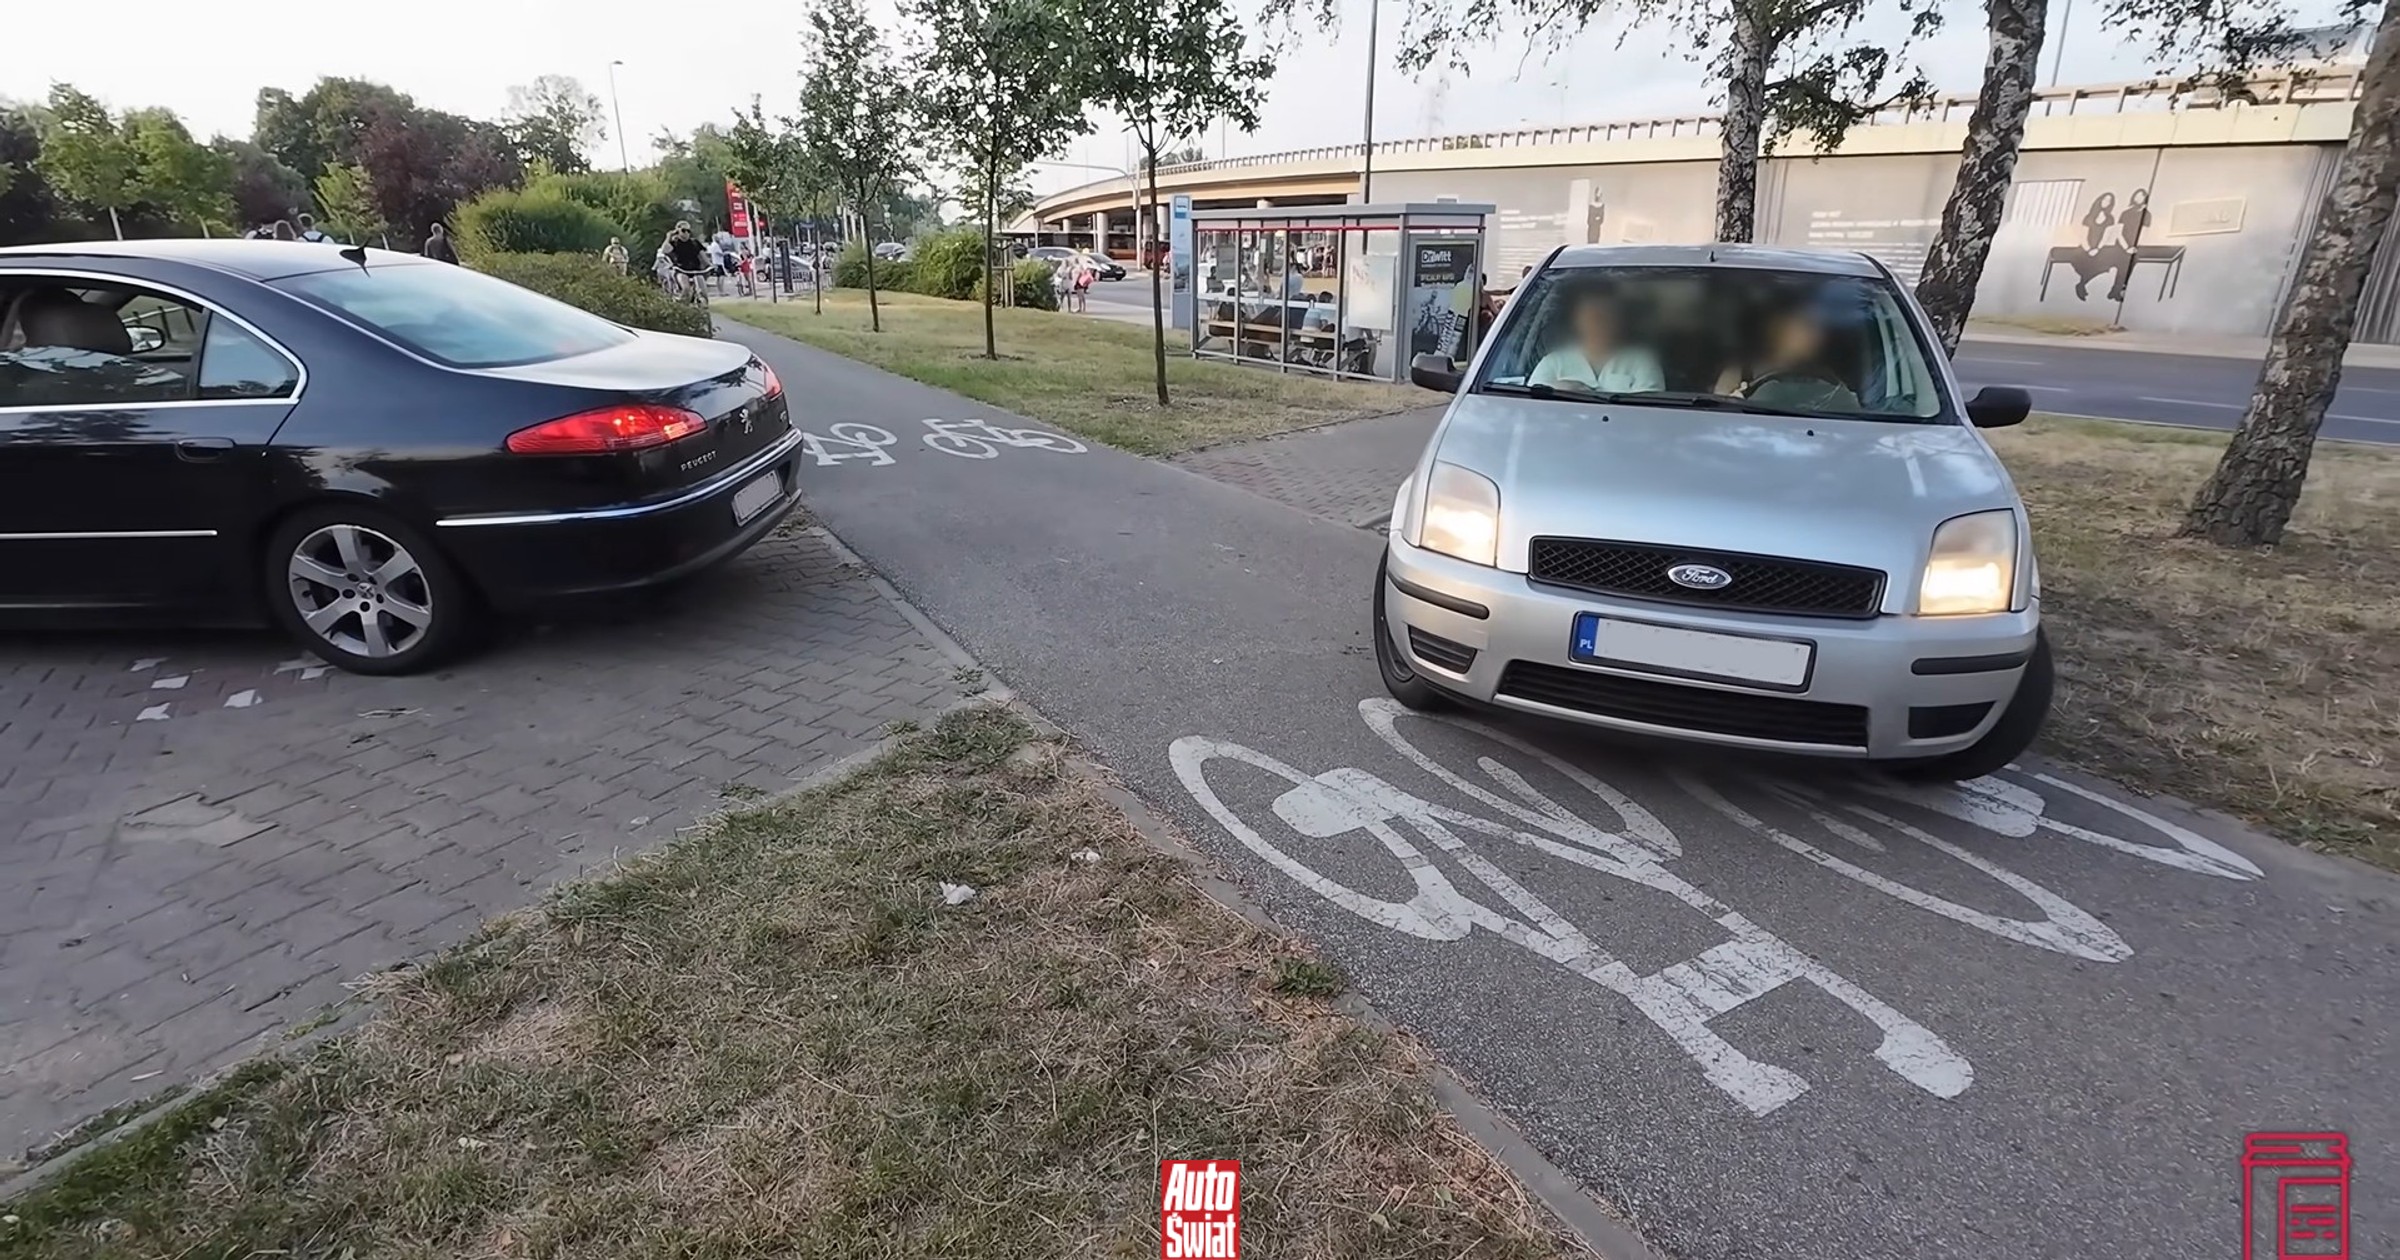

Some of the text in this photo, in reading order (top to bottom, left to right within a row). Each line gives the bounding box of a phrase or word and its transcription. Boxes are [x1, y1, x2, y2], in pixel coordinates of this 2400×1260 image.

[680, 450, 717, 471] PEUGEOT
[1681, 567, 1718, 583] Ford
[1579, 638, 1593, 649] PL
